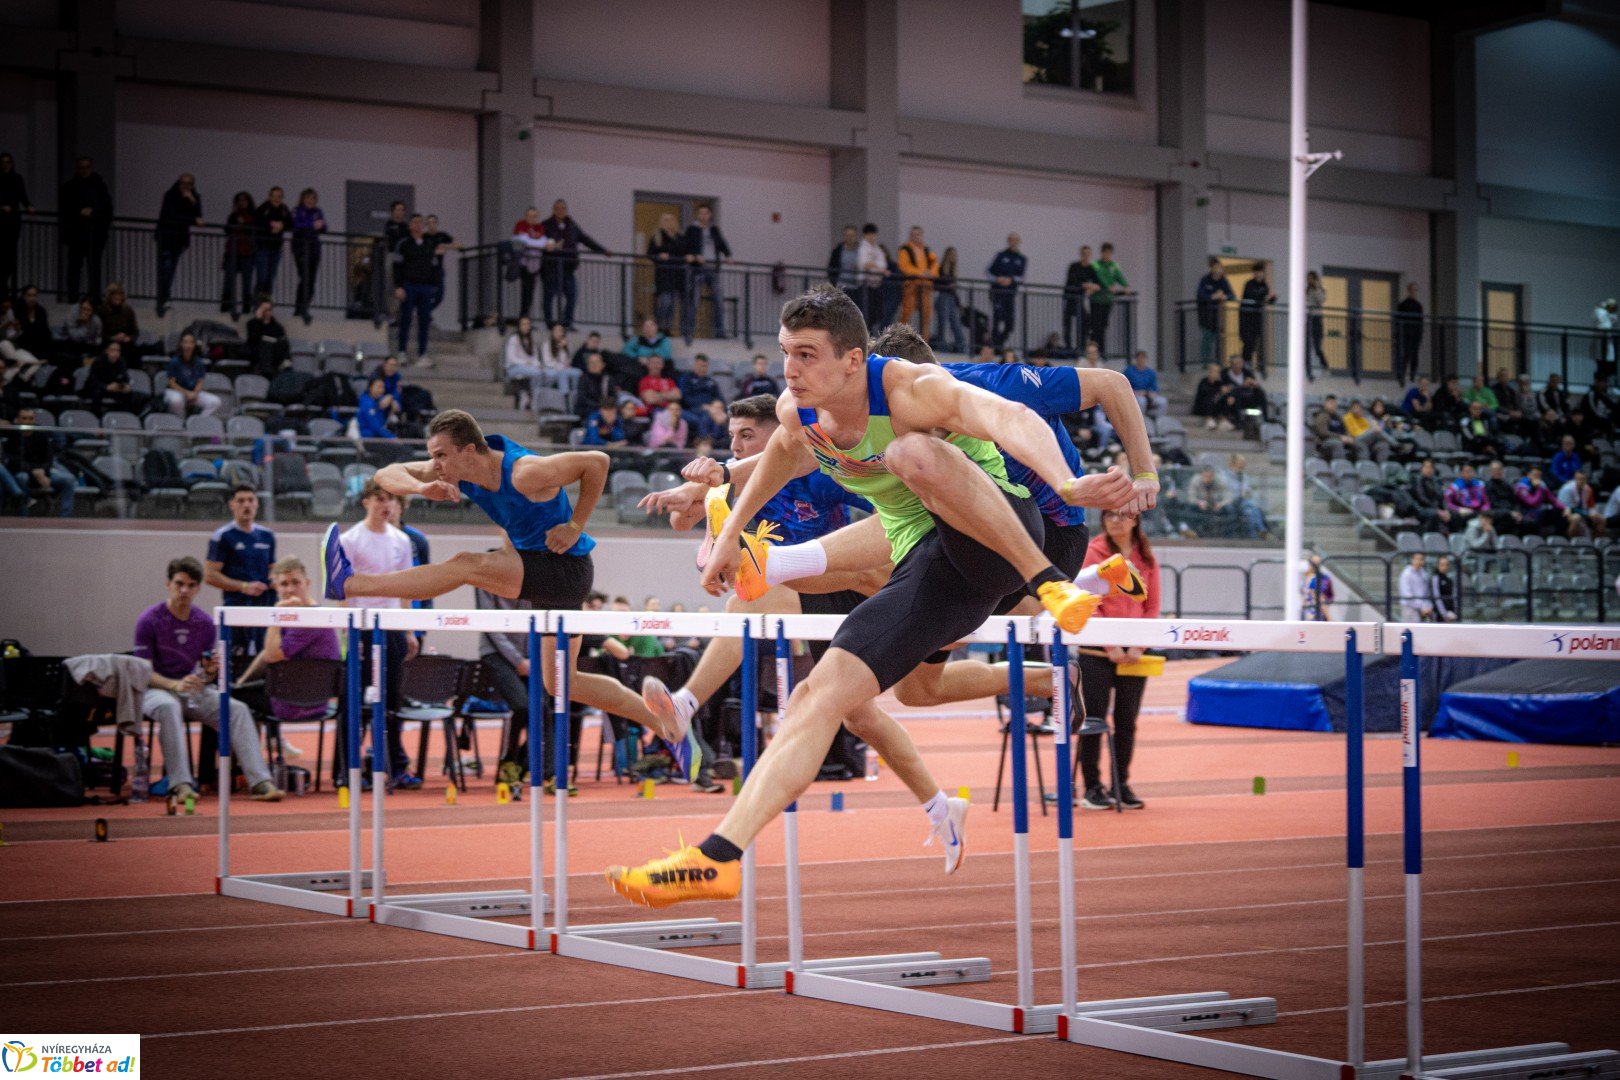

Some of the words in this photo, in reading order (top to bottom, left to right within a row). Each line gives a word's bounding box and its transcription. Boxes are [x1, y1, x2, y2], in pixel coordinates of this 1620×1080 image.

[641, 617, 672, 631] polanik
[1183, 626, 1231, 644] polanik
[649, 867, 718, 884] NITRO
